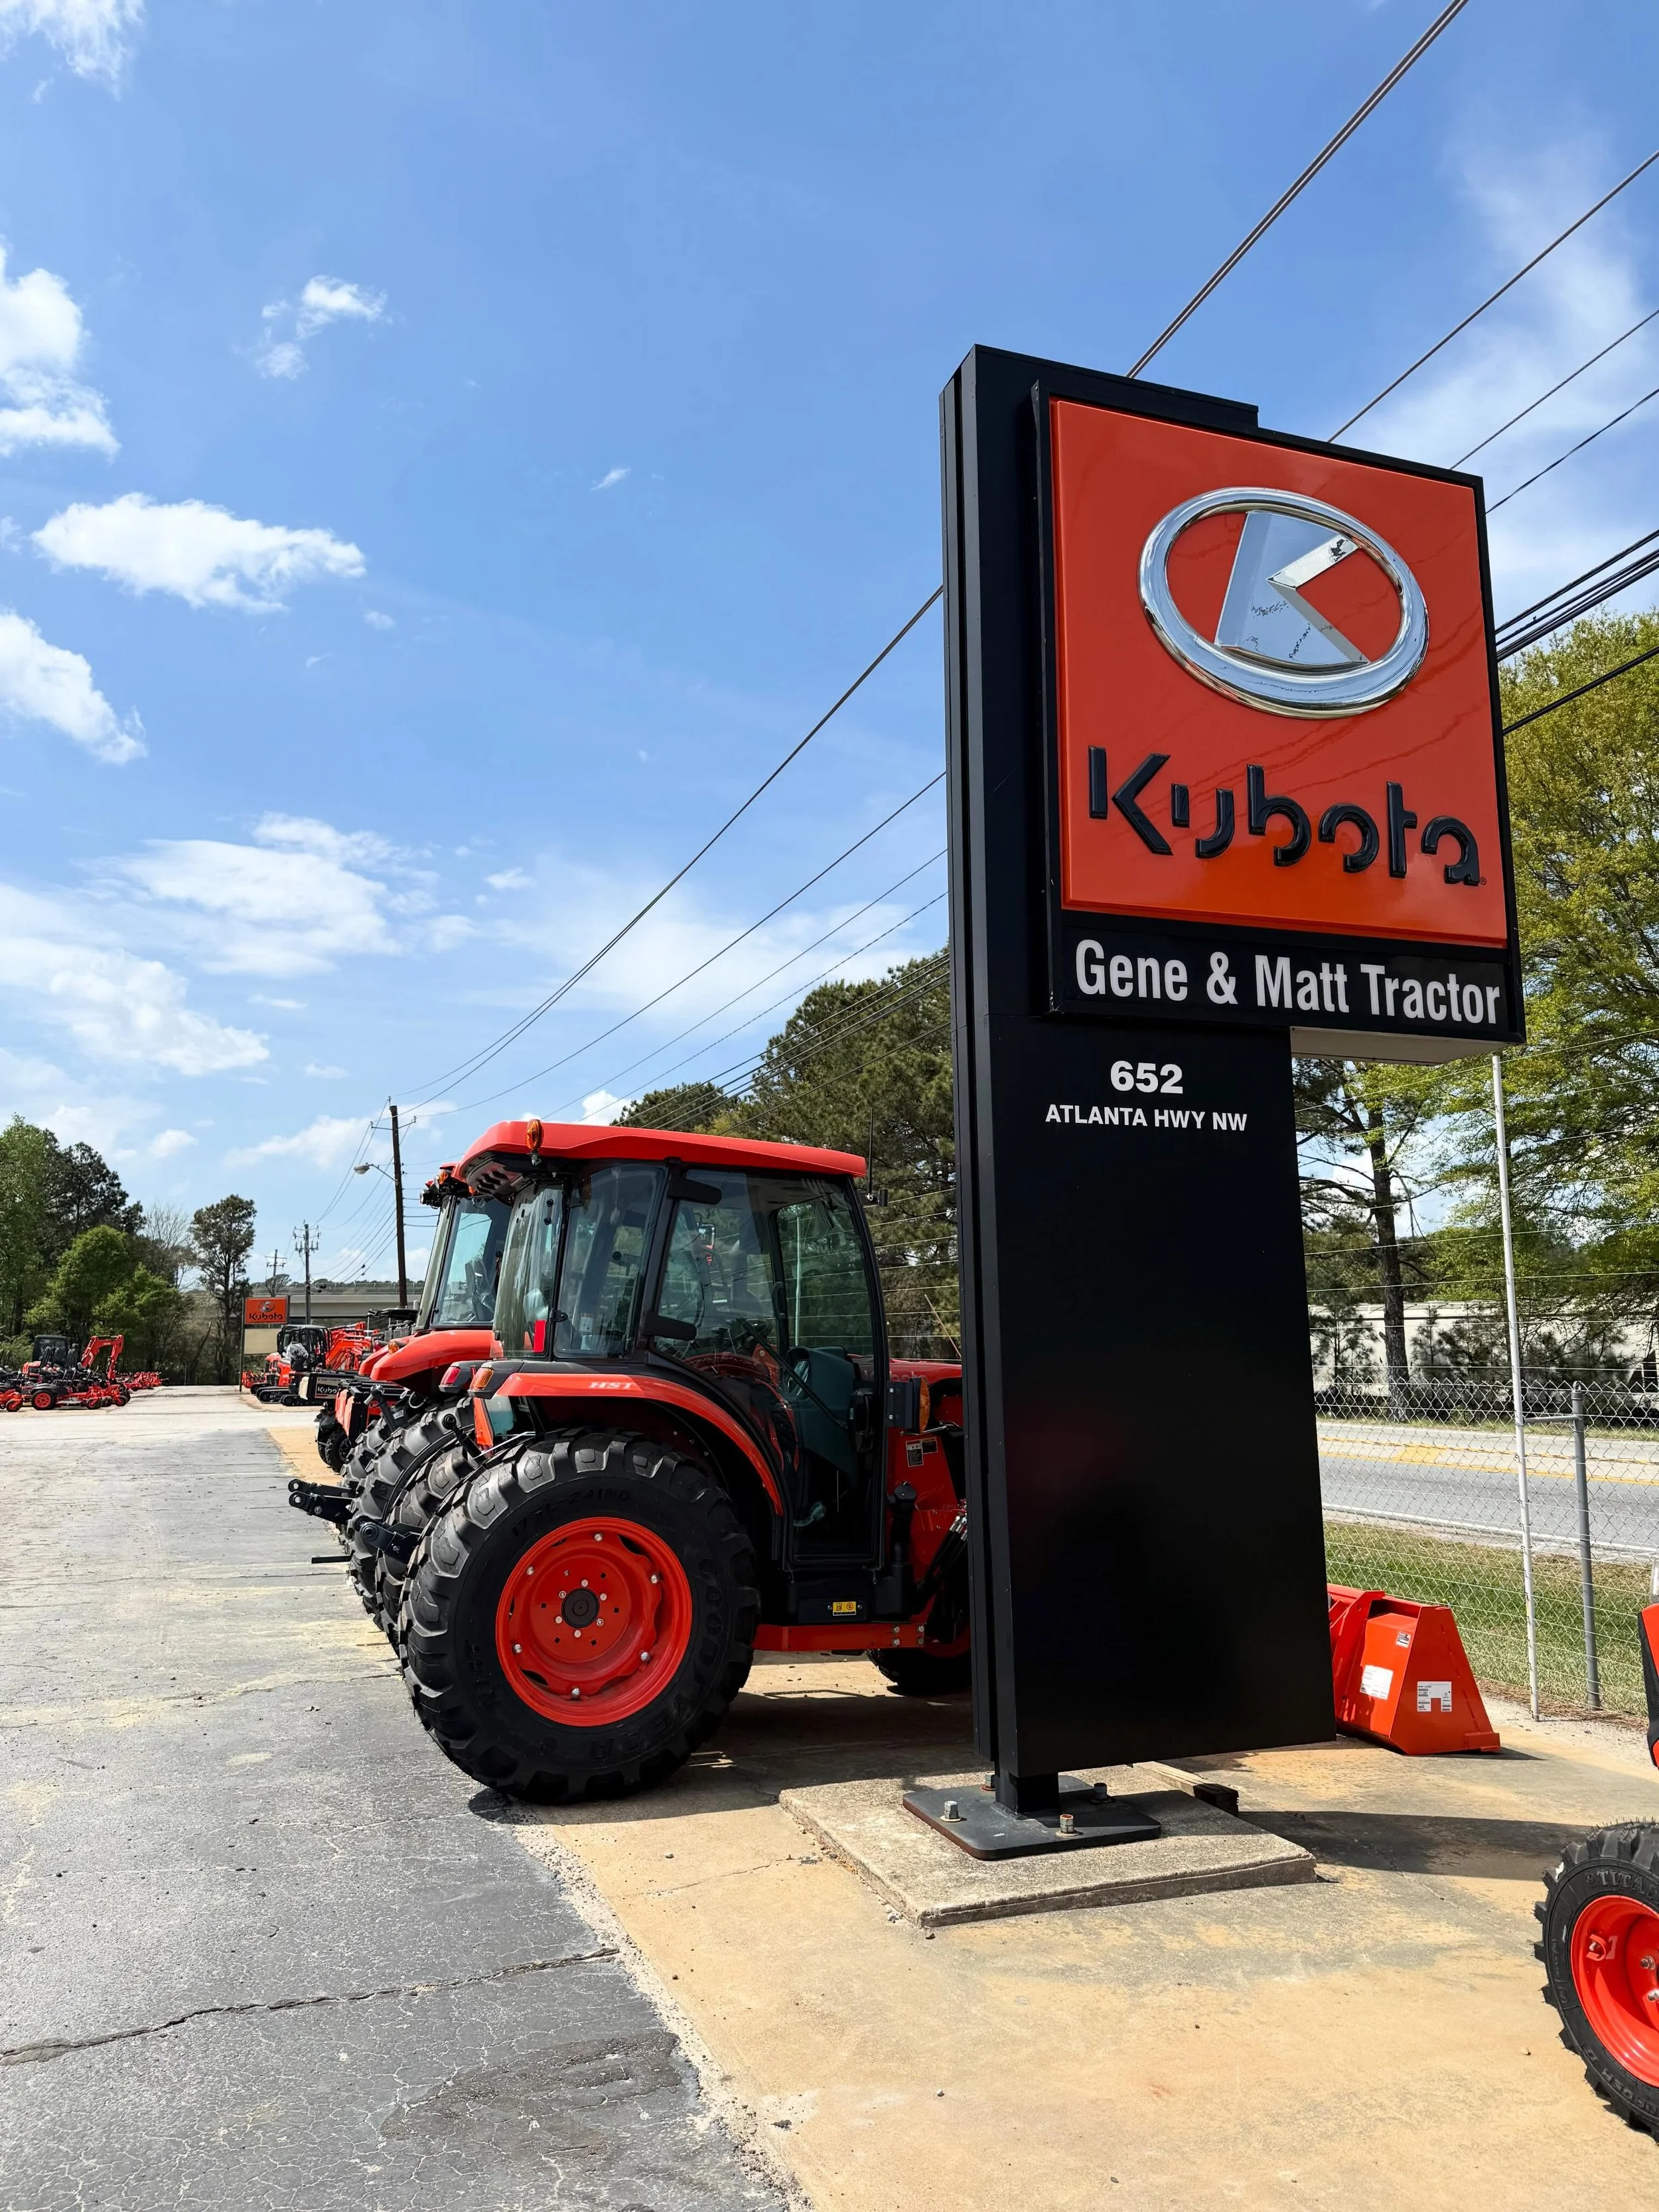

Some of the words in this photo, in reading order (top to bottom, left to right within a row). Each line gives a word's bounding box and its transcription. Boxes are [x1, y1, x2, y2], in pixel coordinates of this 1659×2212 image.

[1088, 745, 1480, 887] Kubota
[1075, 938, 1189, 1001] Gene
[1206, 951, 1239, 1005] &
[1254, 954, 1350, 1013] Matt
[1360, 963, 1500, 1024] Tractor
[1110, 1060, 1184, 1094] 652
[1045, 1104, 1148, 1127] ATLANTA
[1154, 1109, 1206, 1129] HWY
[1212, 1112, 1248, 1132] NW
[249, 1312, 283, 1321] Kubota
[317, 1386, 338, 1394] Kubo
